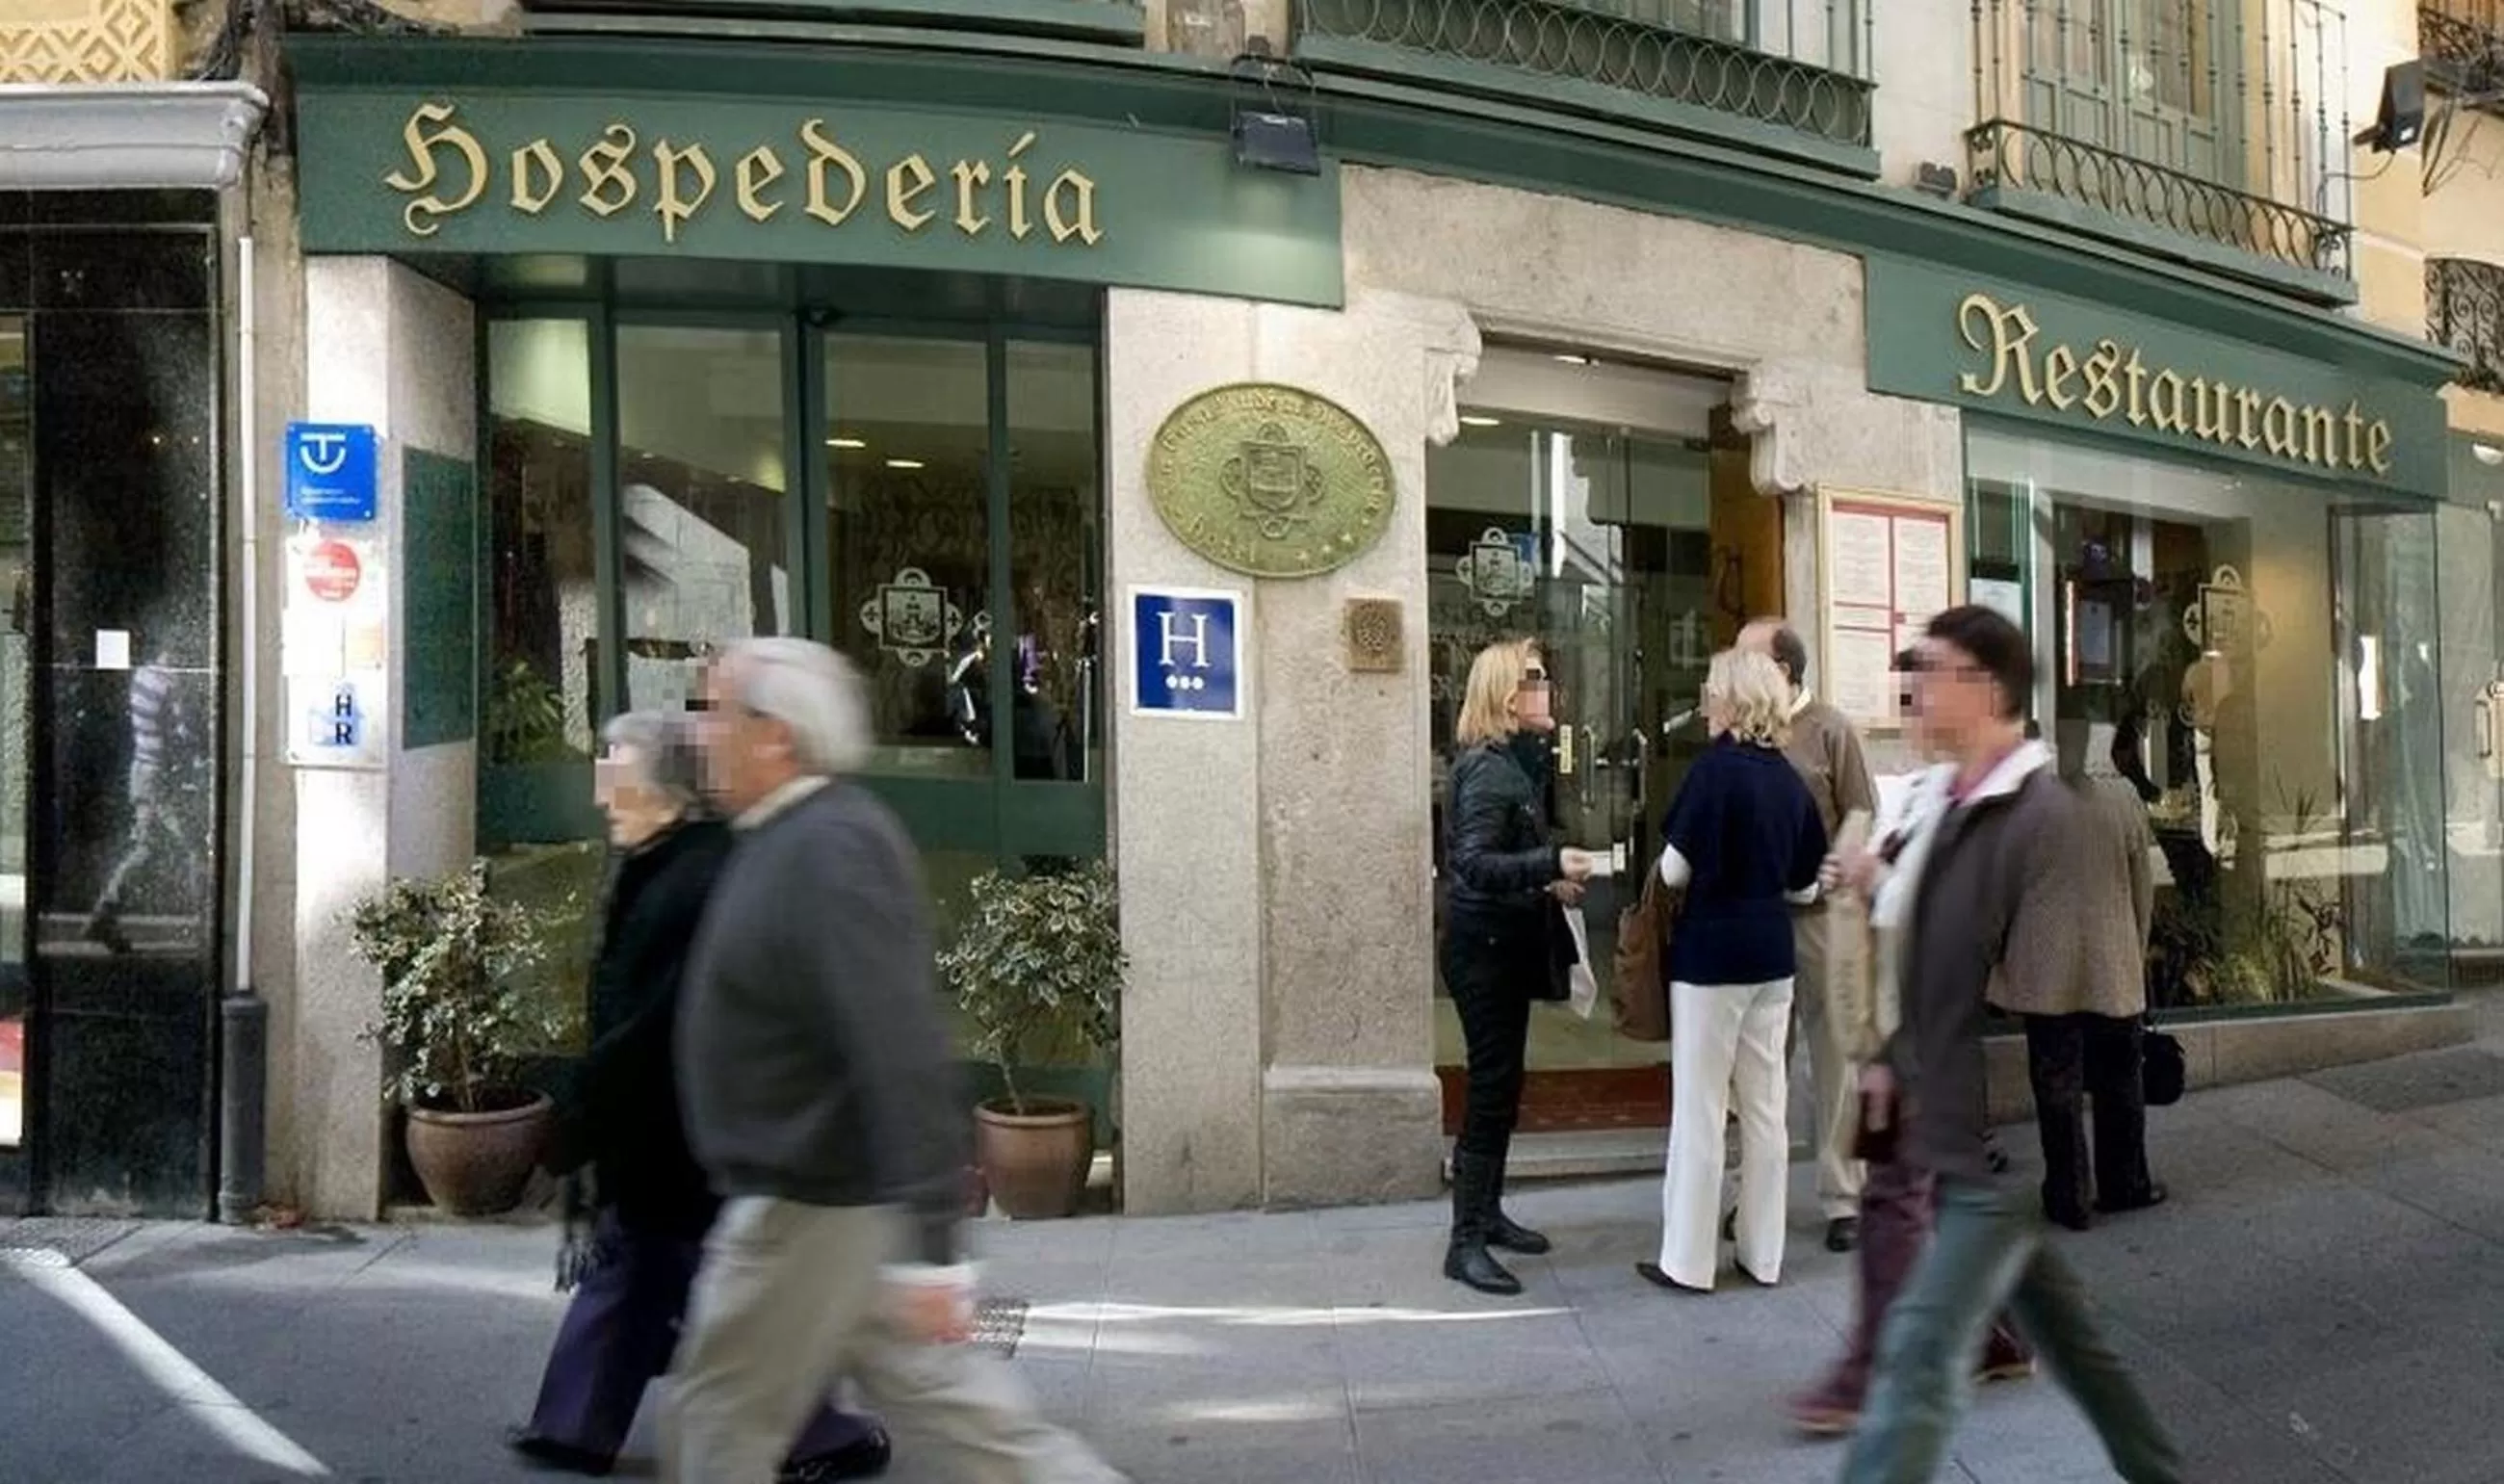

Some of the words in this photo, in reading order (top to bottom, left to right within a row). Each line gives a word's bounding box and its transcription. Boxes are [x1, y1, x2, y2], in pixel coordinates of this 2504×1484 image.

[386, 103, 1105, 245] Hospedería
[1958, 293, 2392, 473] Restaurante
[1156, 611, 1211, 668] H
